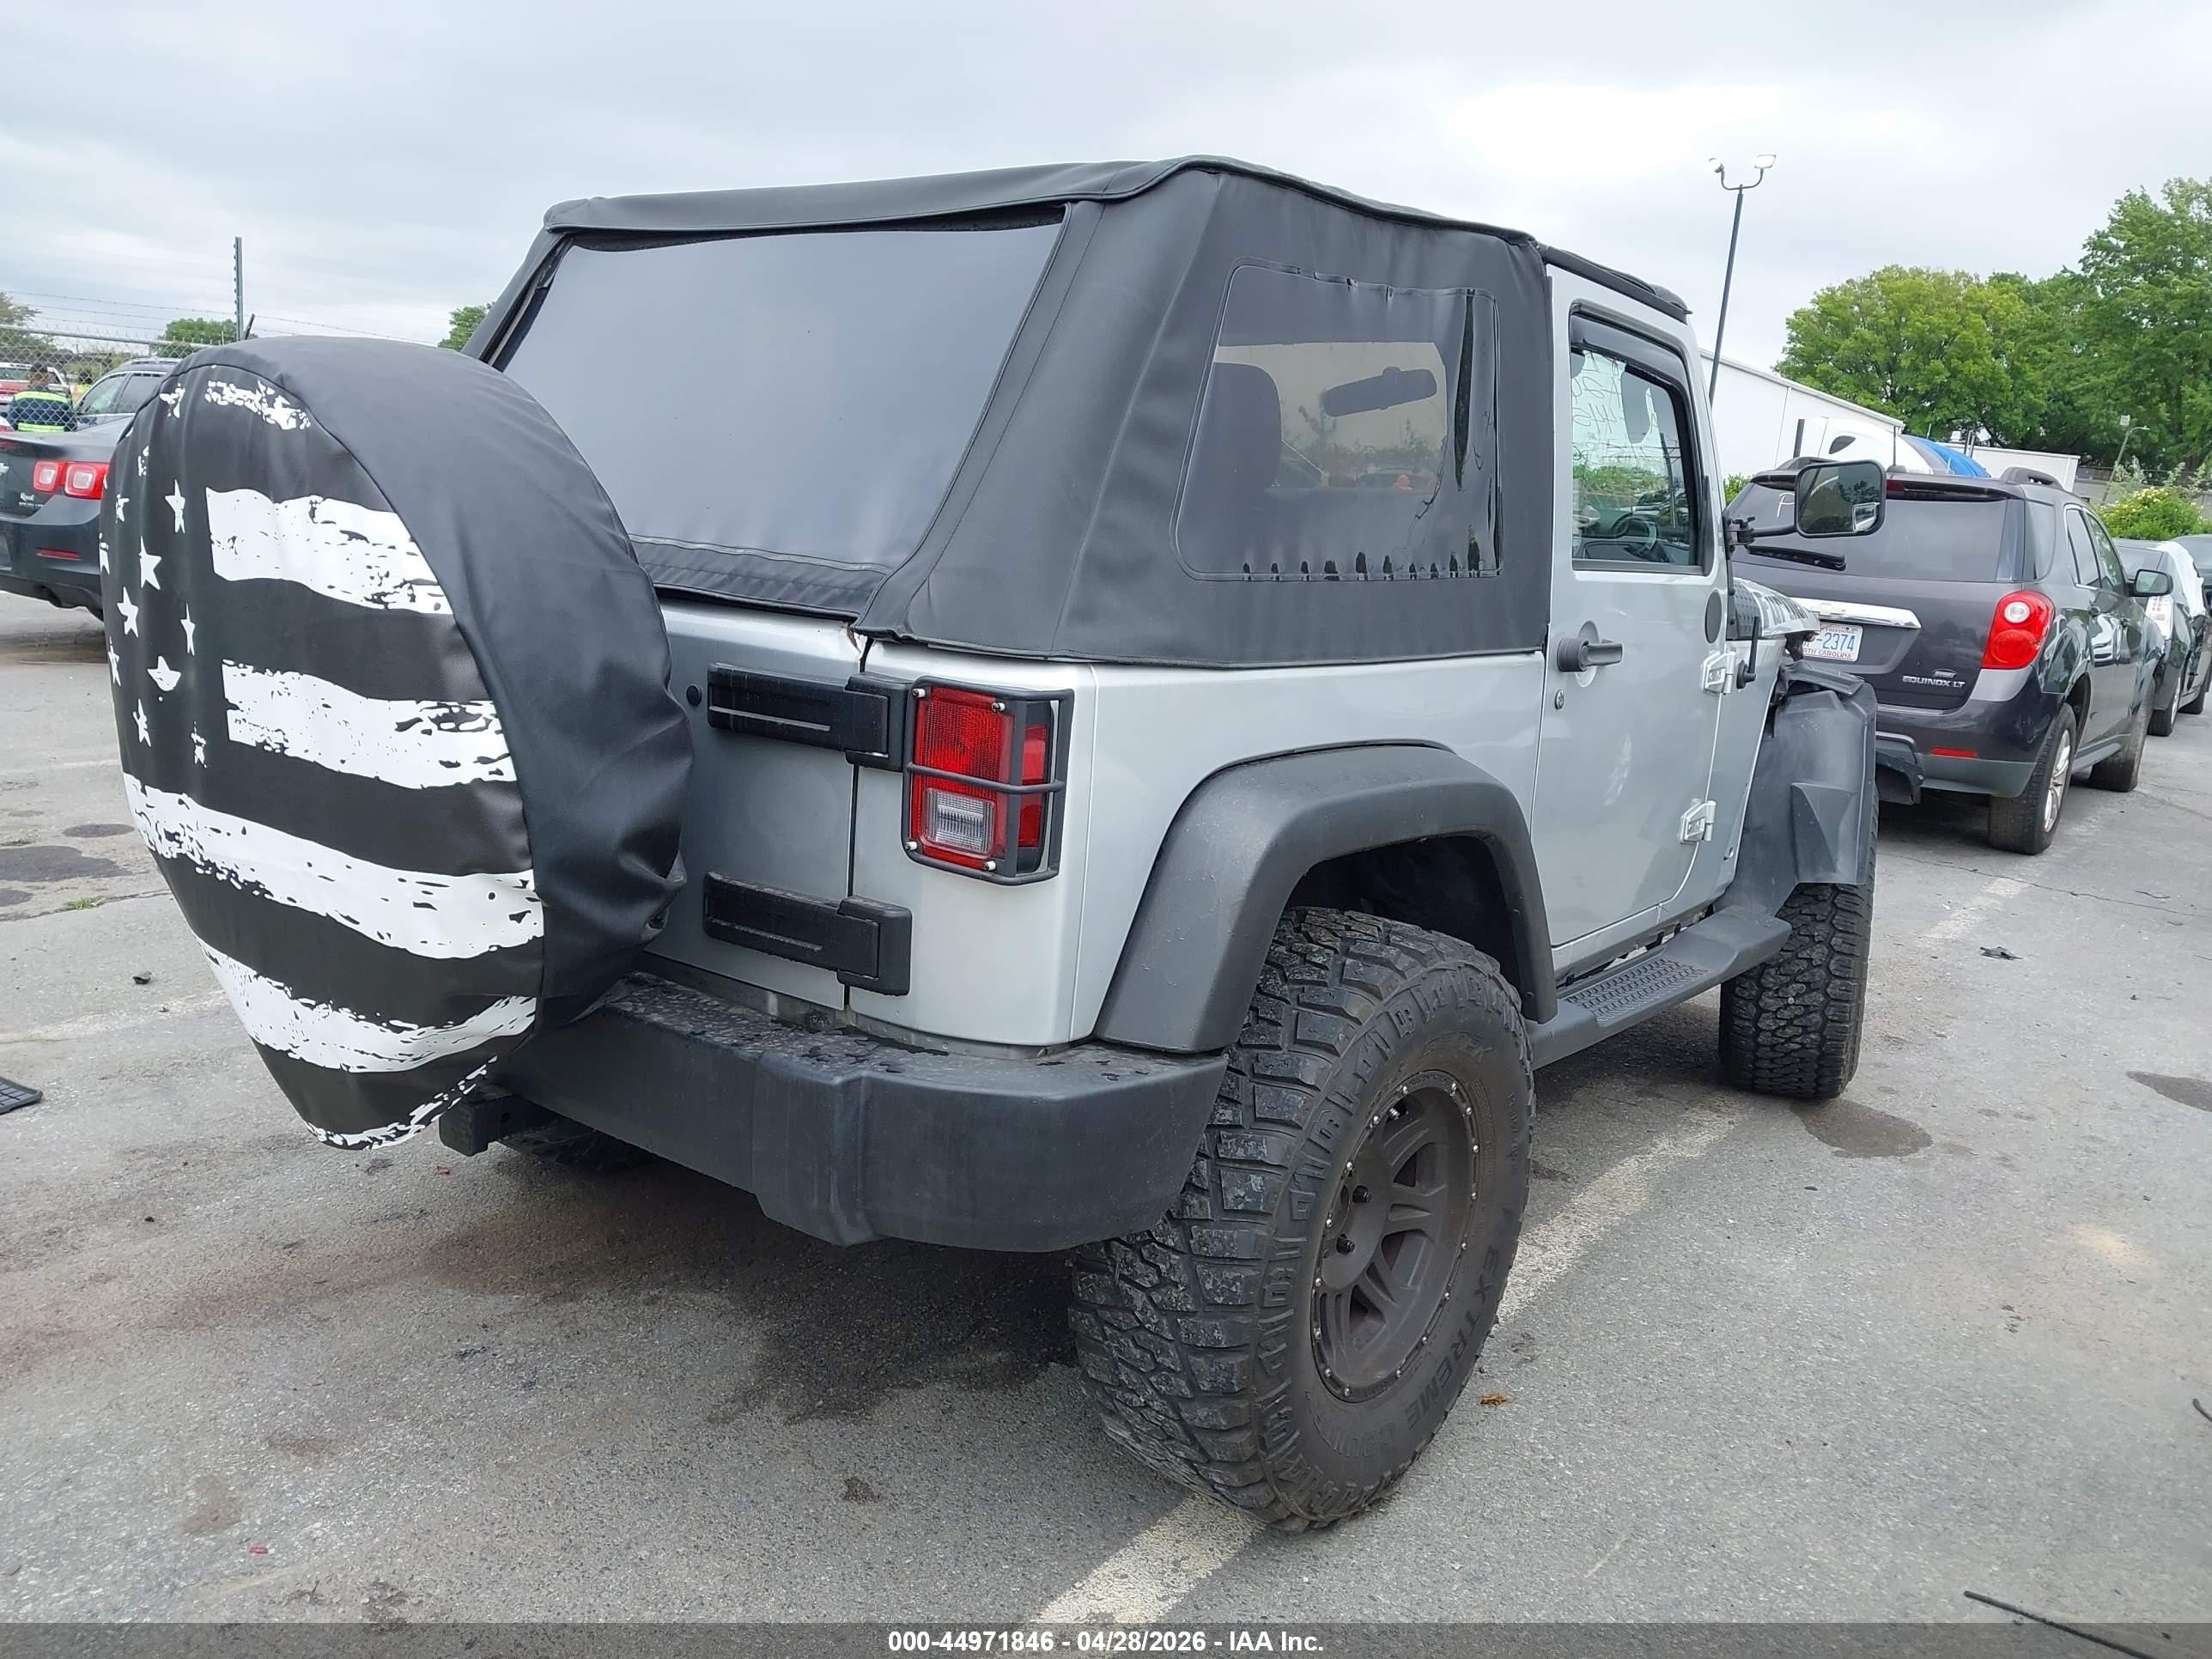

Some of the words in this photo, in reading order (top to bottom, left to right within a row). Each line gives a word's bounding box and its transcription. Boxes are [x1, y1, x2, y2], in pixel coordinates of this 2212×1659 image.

[1818, 650, 1852, 659] CAROLINA
[1902, 675, 1950, 687] EQUINOX
[1405, 1244, 1501, 1430] EXTREME
